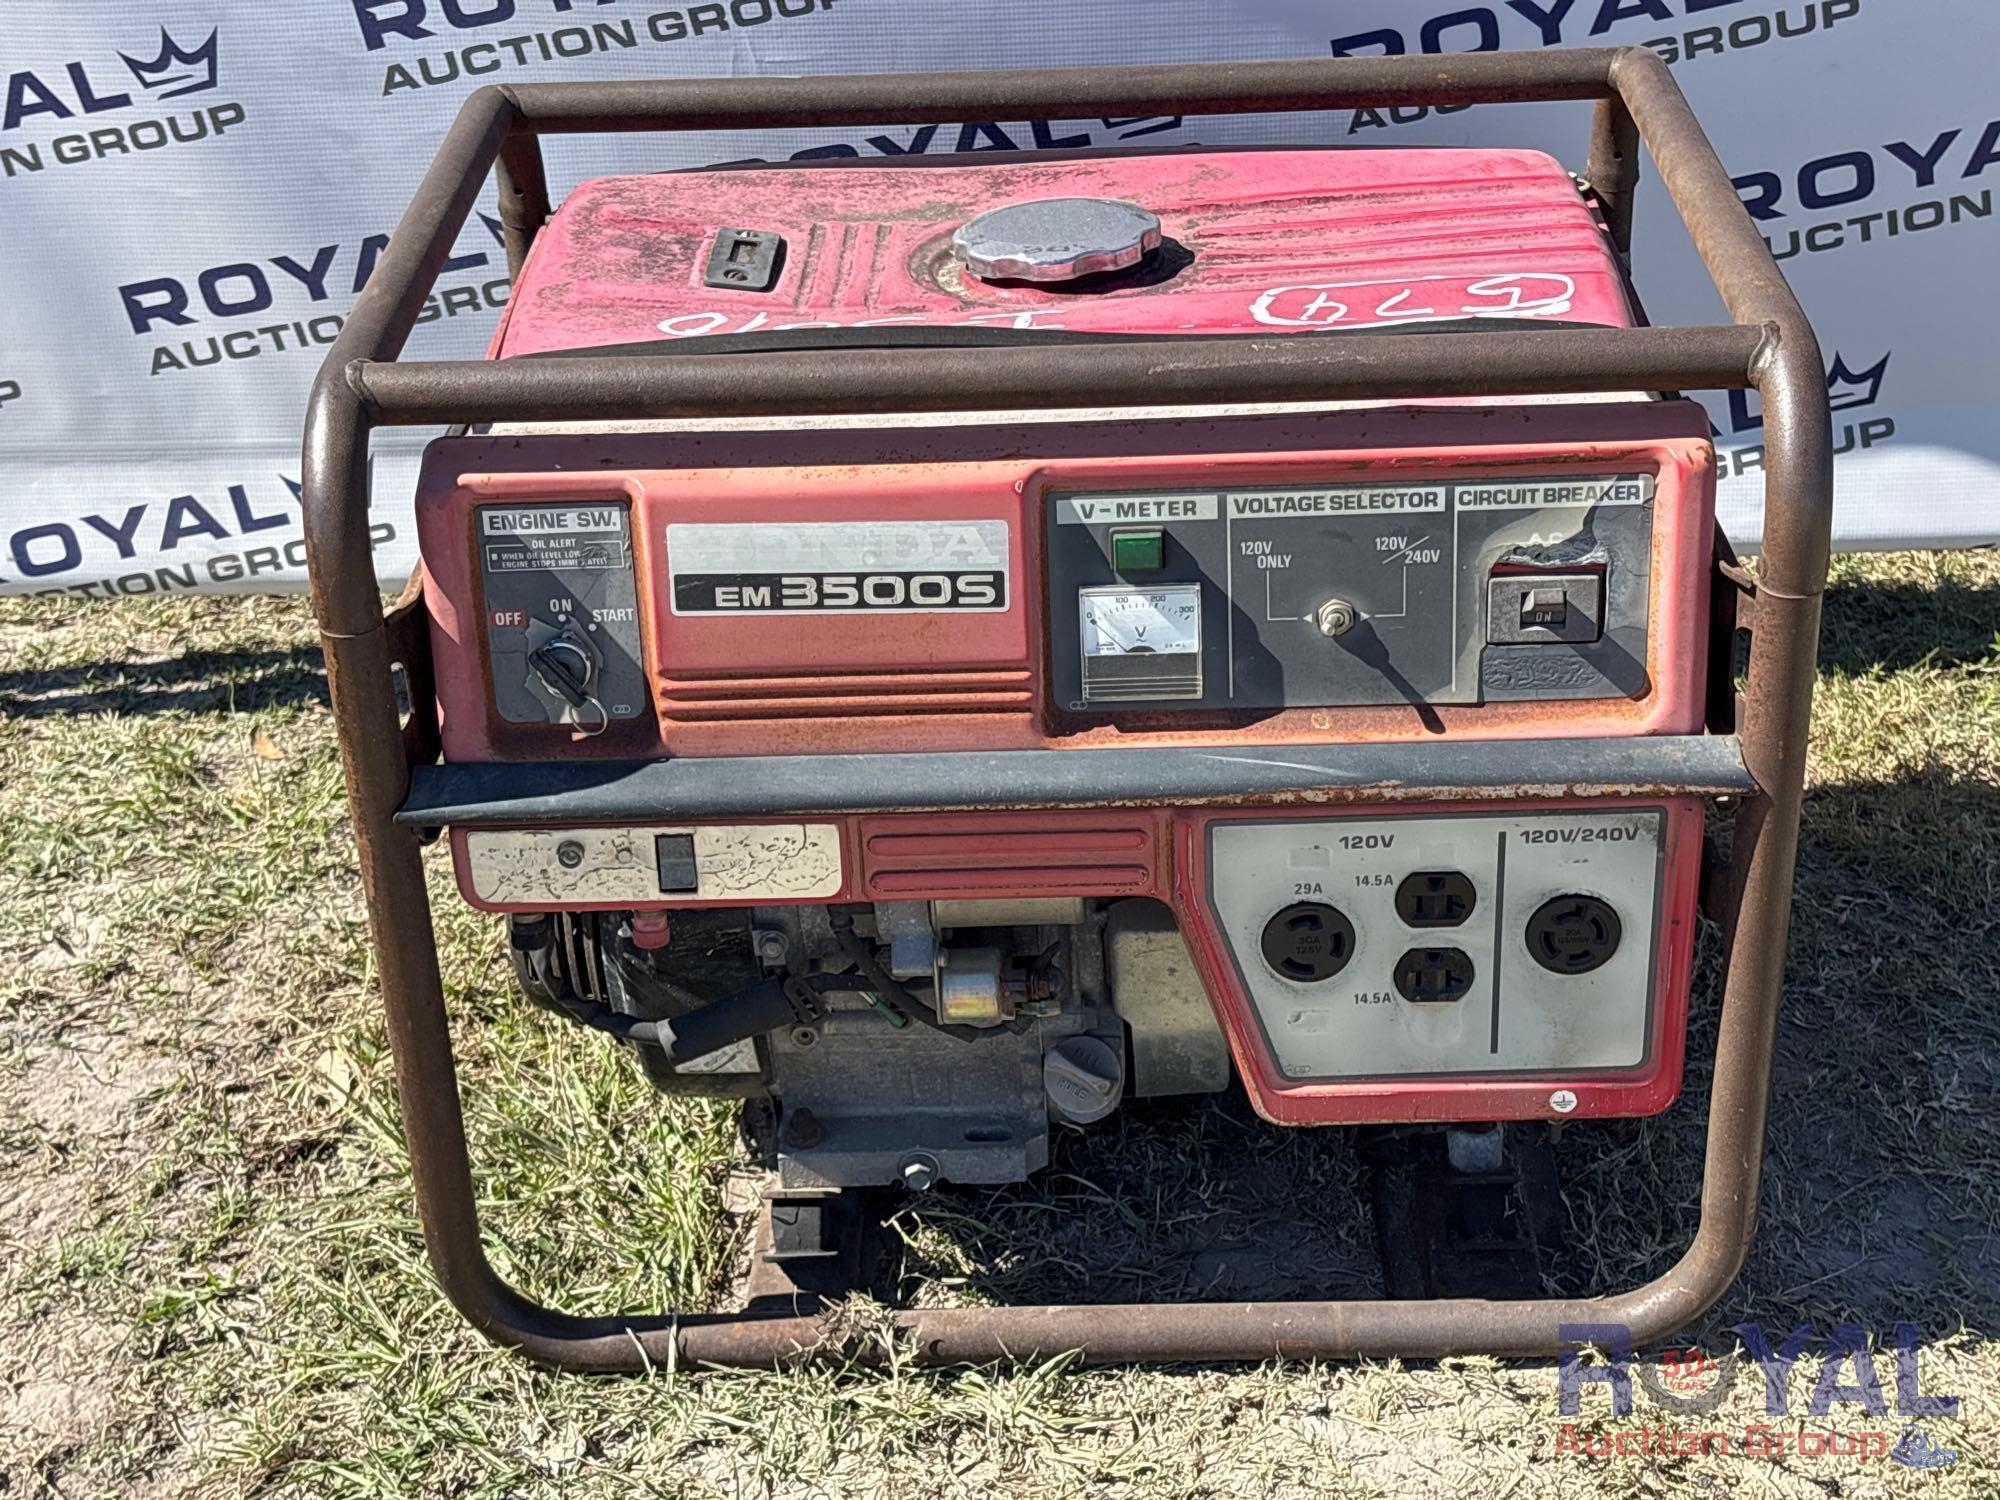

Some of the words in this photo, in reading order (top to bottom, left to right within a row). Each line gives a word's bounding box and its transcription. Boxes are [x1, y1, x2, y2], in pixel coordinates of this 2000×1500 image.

[382, 19, 638, 97] AUCTION
[647, 0, 846, 43] GROU
[52, 102, 246, 164] GROUP
[704, 119, 1091, 168] YAL
[1763, 189, 1992, 260] UCTION
[150, 311, 350, 376] AUCTIO
[1233, 495, 1325, 514] VOLTAGE
[1330, 491, 1438, 511] SELECTOR
[1458, 487, 1540, 506] CIRCUIT
[1544, 484, 1641, 504] BREAKER
[489, 512, 569, 531] ENGINE
[577, 511, 617, 529] SW.
[0, 484, 291, 583] OYAL
[532, 539, 546, 549] OIL
[550, 538, 576, 549] ALERT
[1241, 540, 1273, 556] 120V
[207, 523, 396, 582] GROP
[502, 552, 524, 560] WHEN
[541, 551, 562, 559] LEVEL
[1404, 549, 1441, 564] 240V
[502, 560, 528, 569] ENGINE
[532, 559, 555, 568] STOPS
[1257, 554, 1292, 570] ONLY
[549, 598, 572, 612] ON
[1115, 596, 1129, 604] 100
[495, 612, 522, 626] OFF
[592, 608, 634, 623] START
[1178, 605, 1195, 613] 300
[1535, 611, 1552, 623] ON
[1339, 834, 1395, 850] 120V
[1520, 826, 1640, 844] 120V/240V
[1355, 874, 1394, 887] 14.5A
[1294, 883, 1323, 895] 29A
[1354, 993, 1392, 1005] 14.5A
